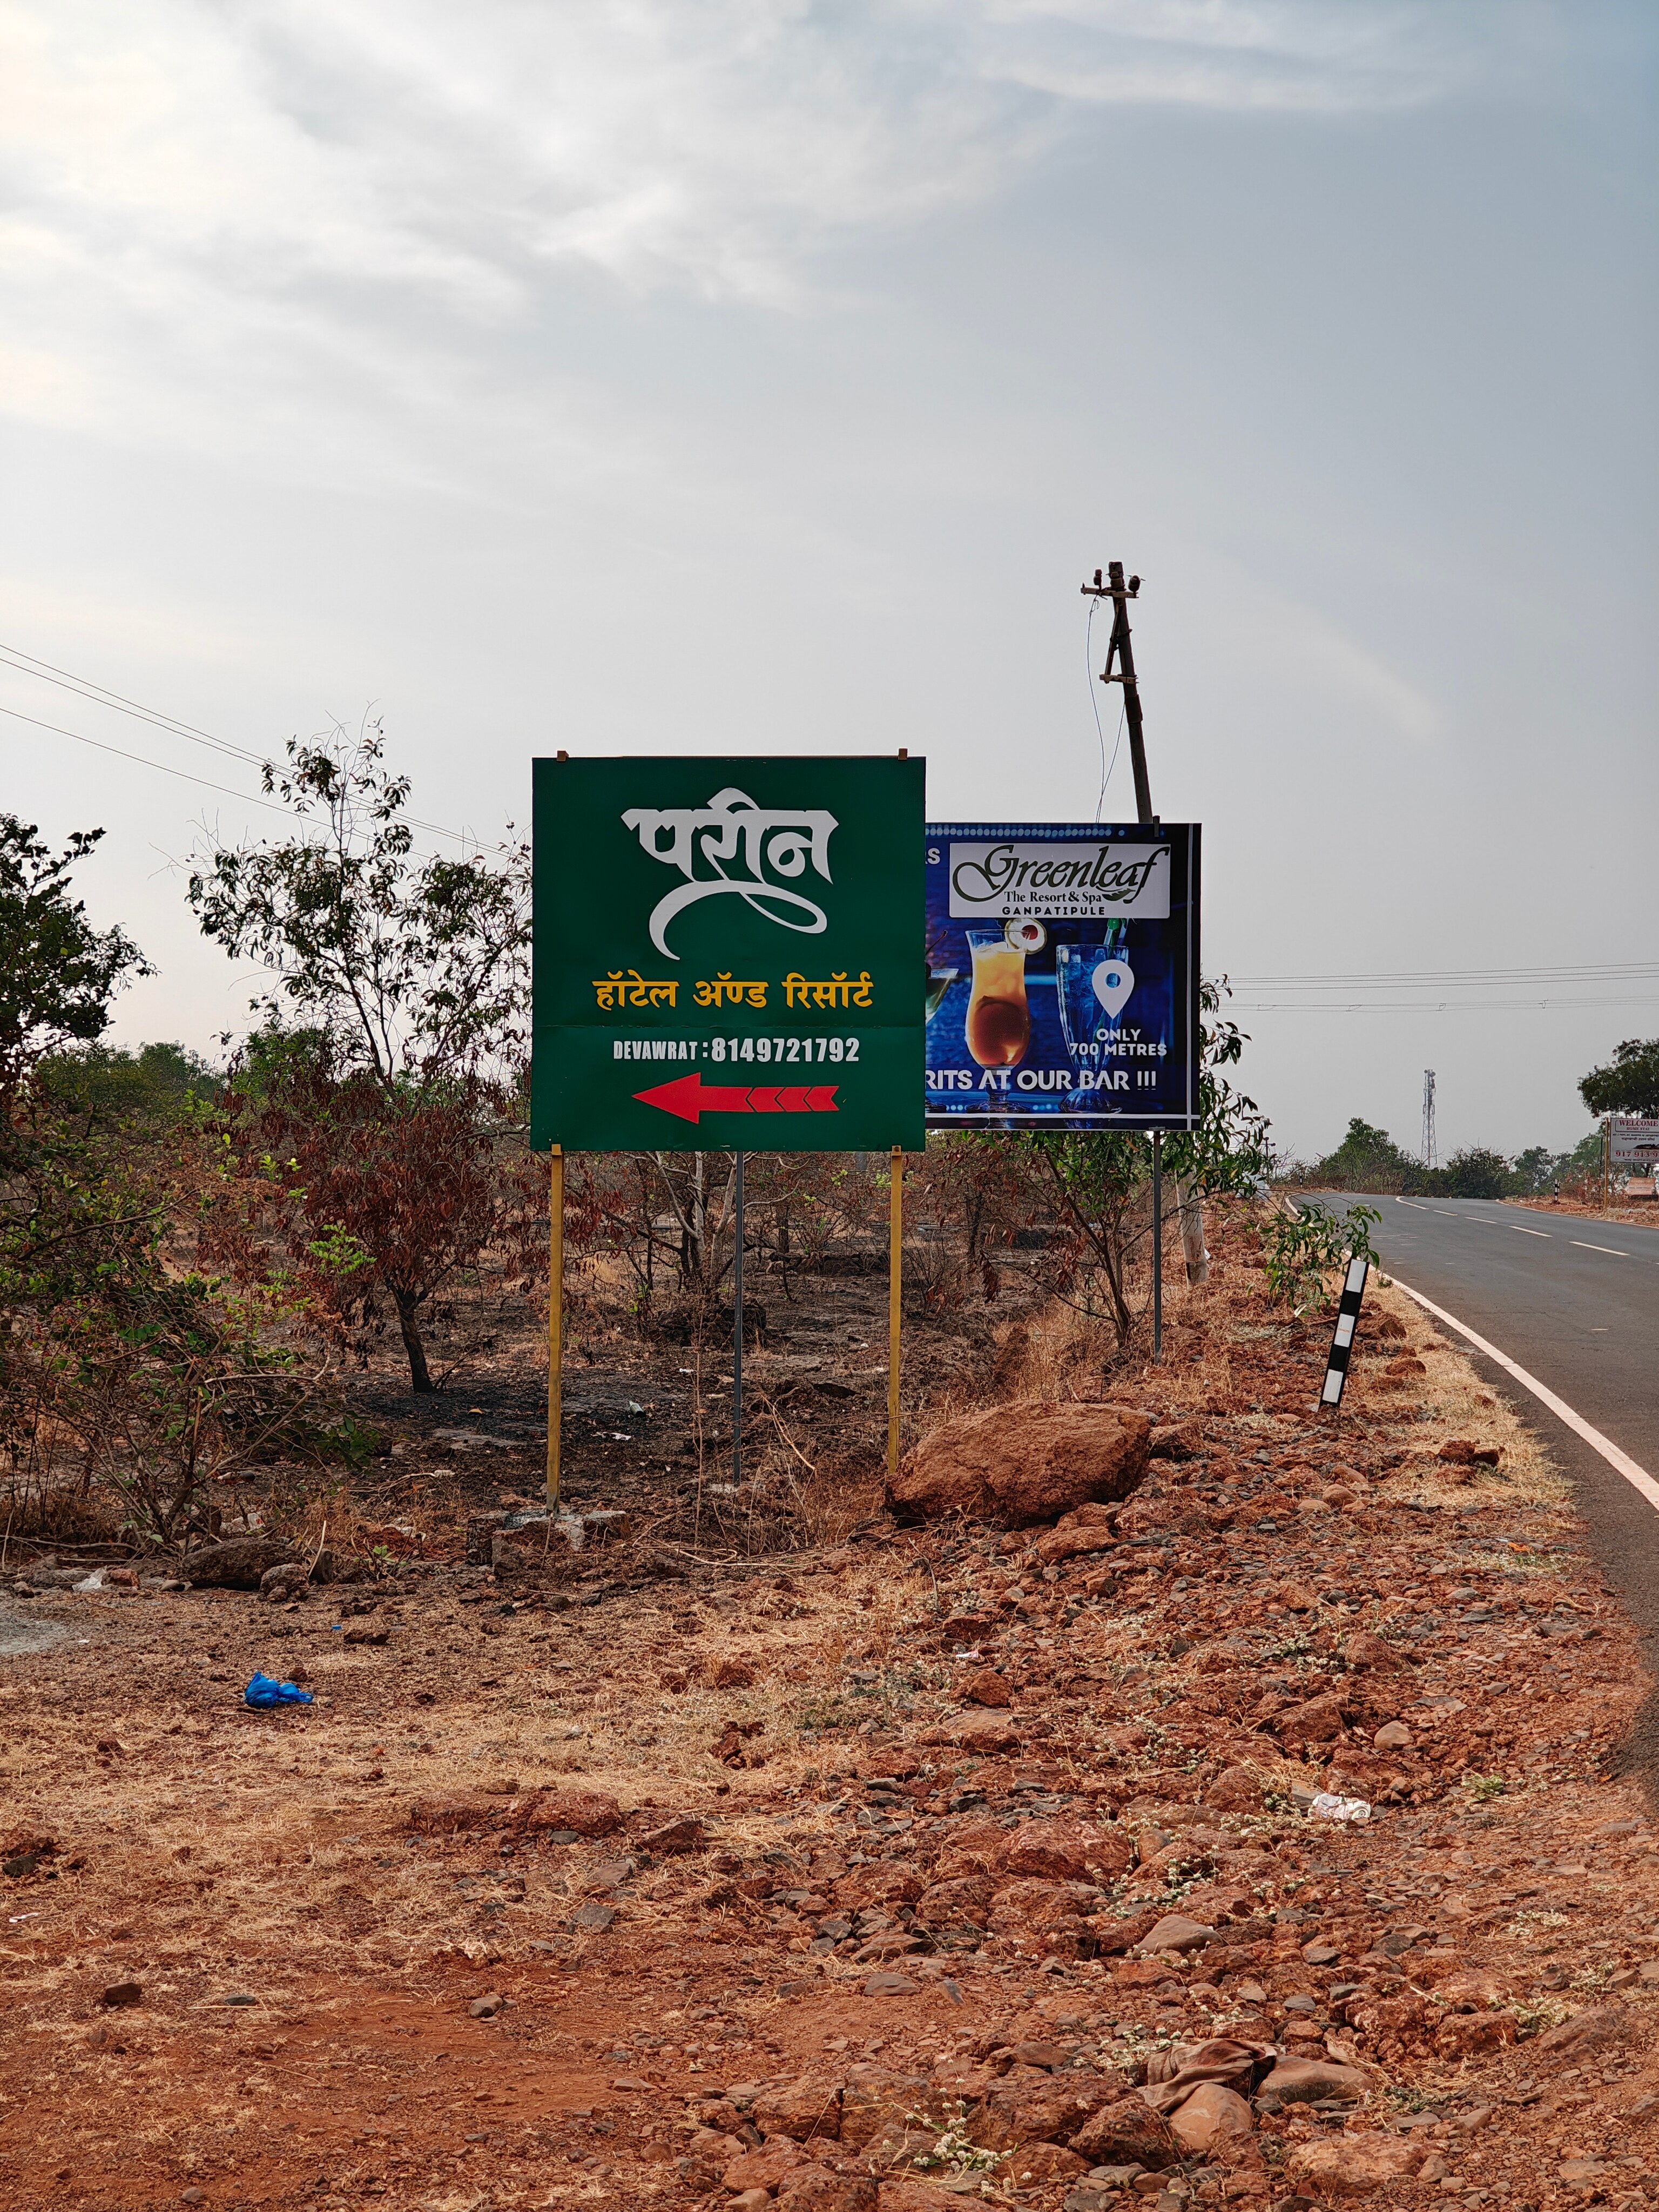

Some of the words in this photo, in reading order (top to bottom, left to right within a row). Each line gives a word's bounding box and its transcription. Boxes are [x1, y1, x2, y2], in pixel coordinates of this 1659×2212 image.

[925, 847, 941, 865] S
[952, 845, 1170, 903] Greenleaf
[1004, 891, 1026, 902] The
[1030, 891, 1067, 902] Resort
[1068, 891, 1080, 902] &
[1082, 891, 1102, 905] Spa
[1002, 906, 1105, 915] GANPATIPULE
[592, 969, 680, 1011] हॉटेल
[781, 971, 874, 1009] रिसॉर्ट
[1096, 1028, 1141, 1041] ONLY
[613, 1041, 698, 1060] DEVAWRAT
[1070, 1043, 1098, 1056] 700
[1104, 1043, 1167, 1056] METRES
[978, 1070, 1011, 1090] AT
[1017, 1070, 1073, 1090] OUR
[1080, 1070, 1130, 1090] BAR
[1137, 1071, 1156, 1090] !!!
